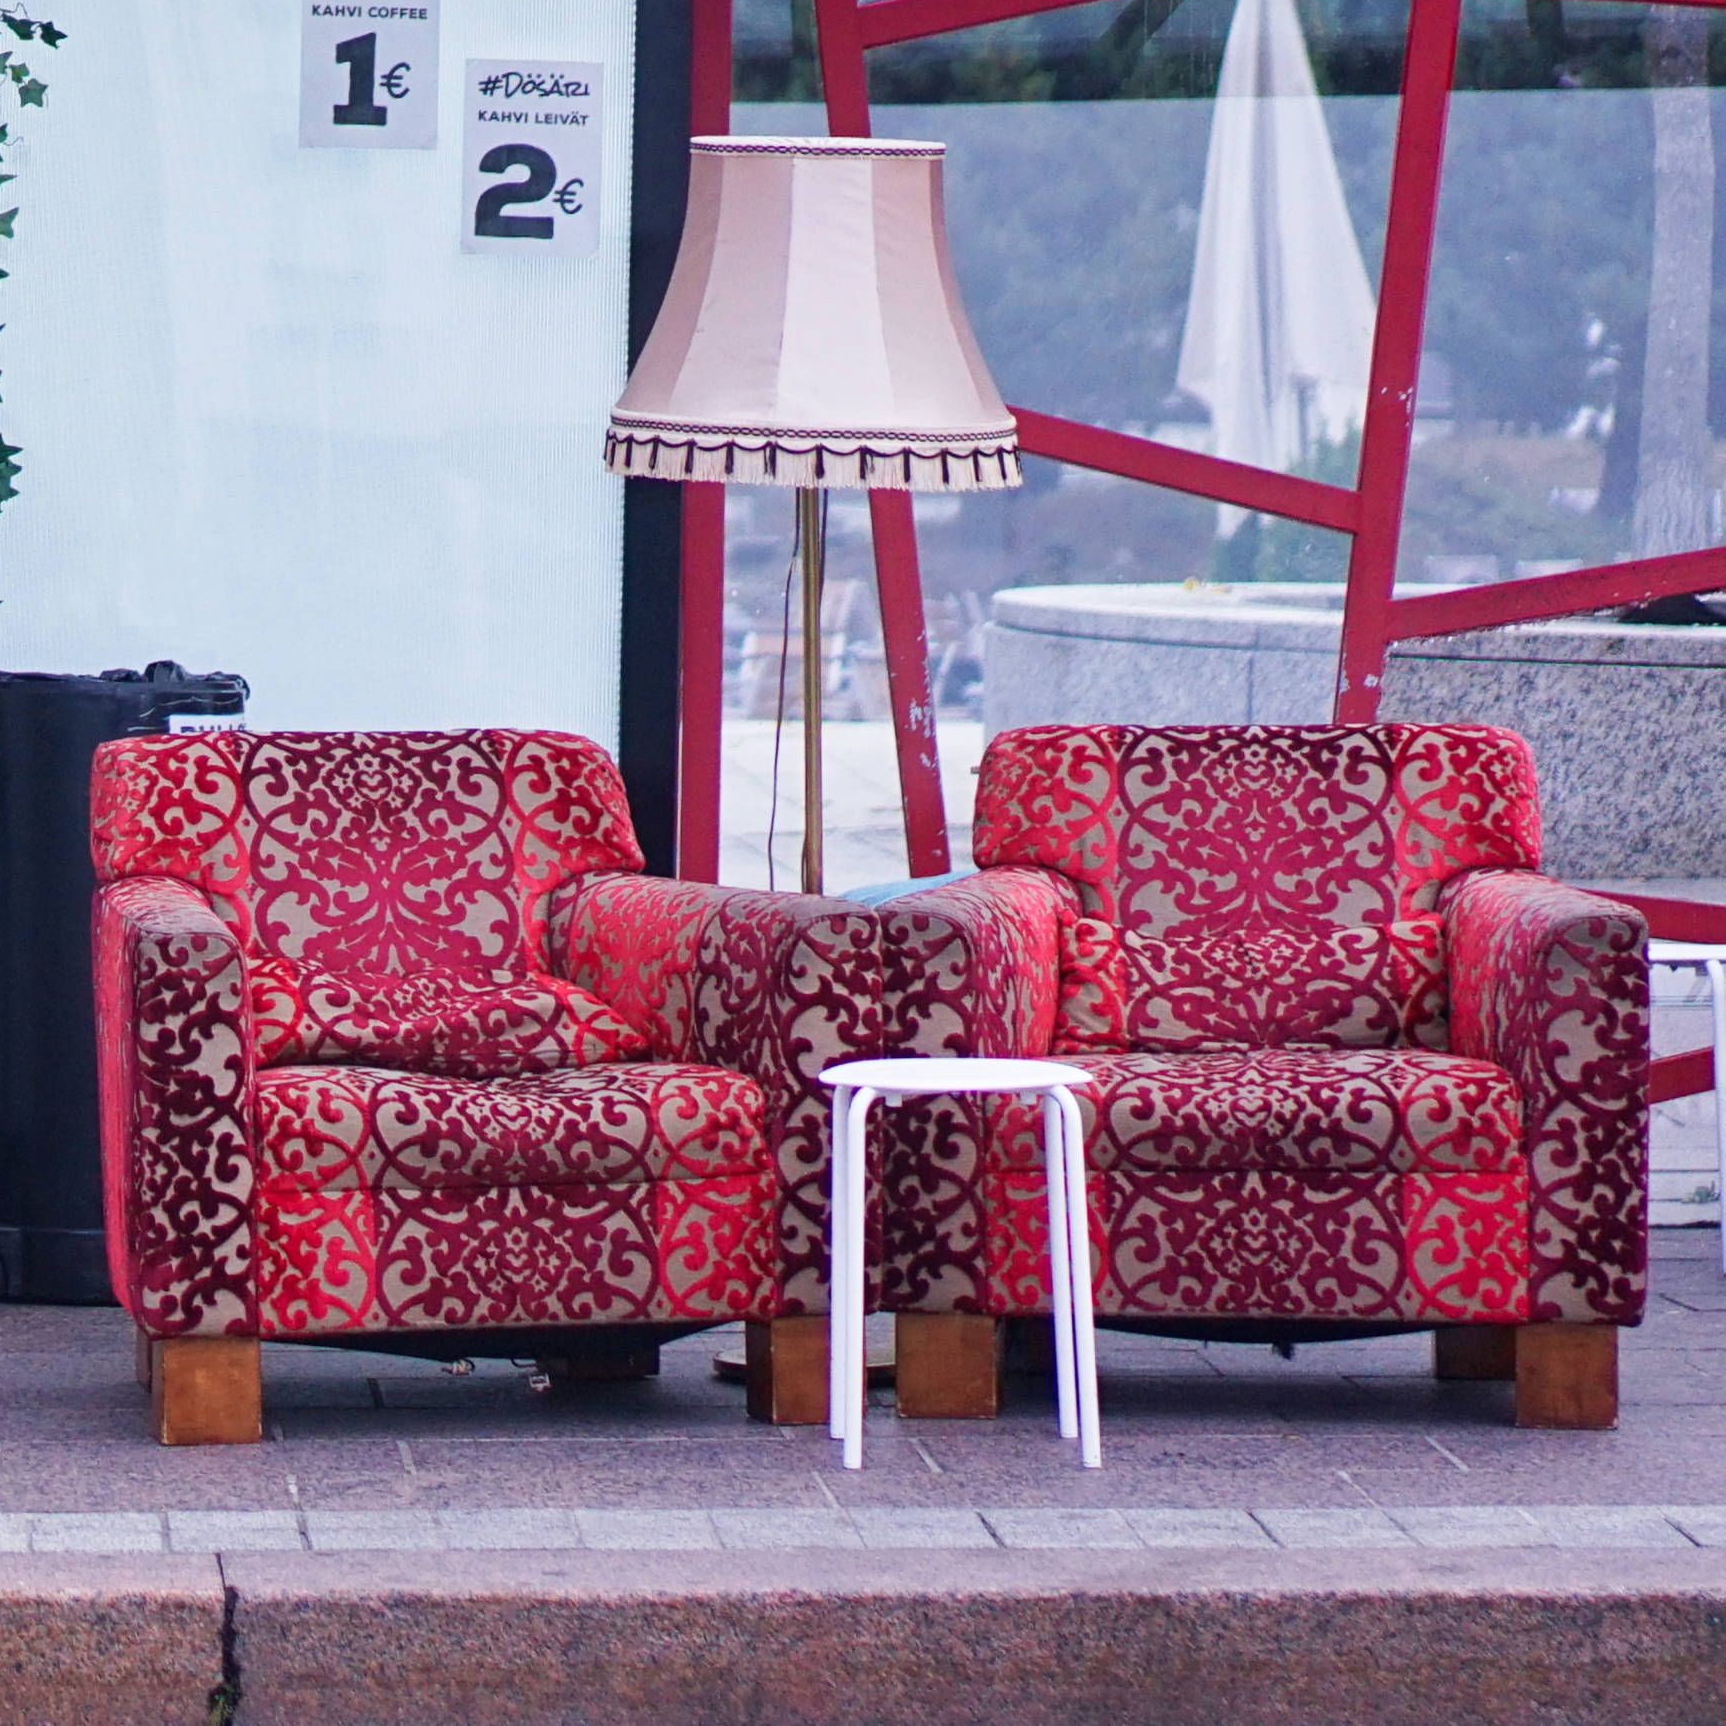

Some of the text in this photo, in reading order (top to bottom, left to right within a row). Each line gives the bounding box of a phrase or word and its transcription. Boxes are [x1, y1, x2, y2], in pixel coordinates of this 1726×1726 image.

[311, 4, 429, 20] KAHVI COFFEE
[332, 31, 412, 127] 1€
[477, 110, 589, 127] KAHVI LEIVÄT
[474, 142, 585, 240] 2€
